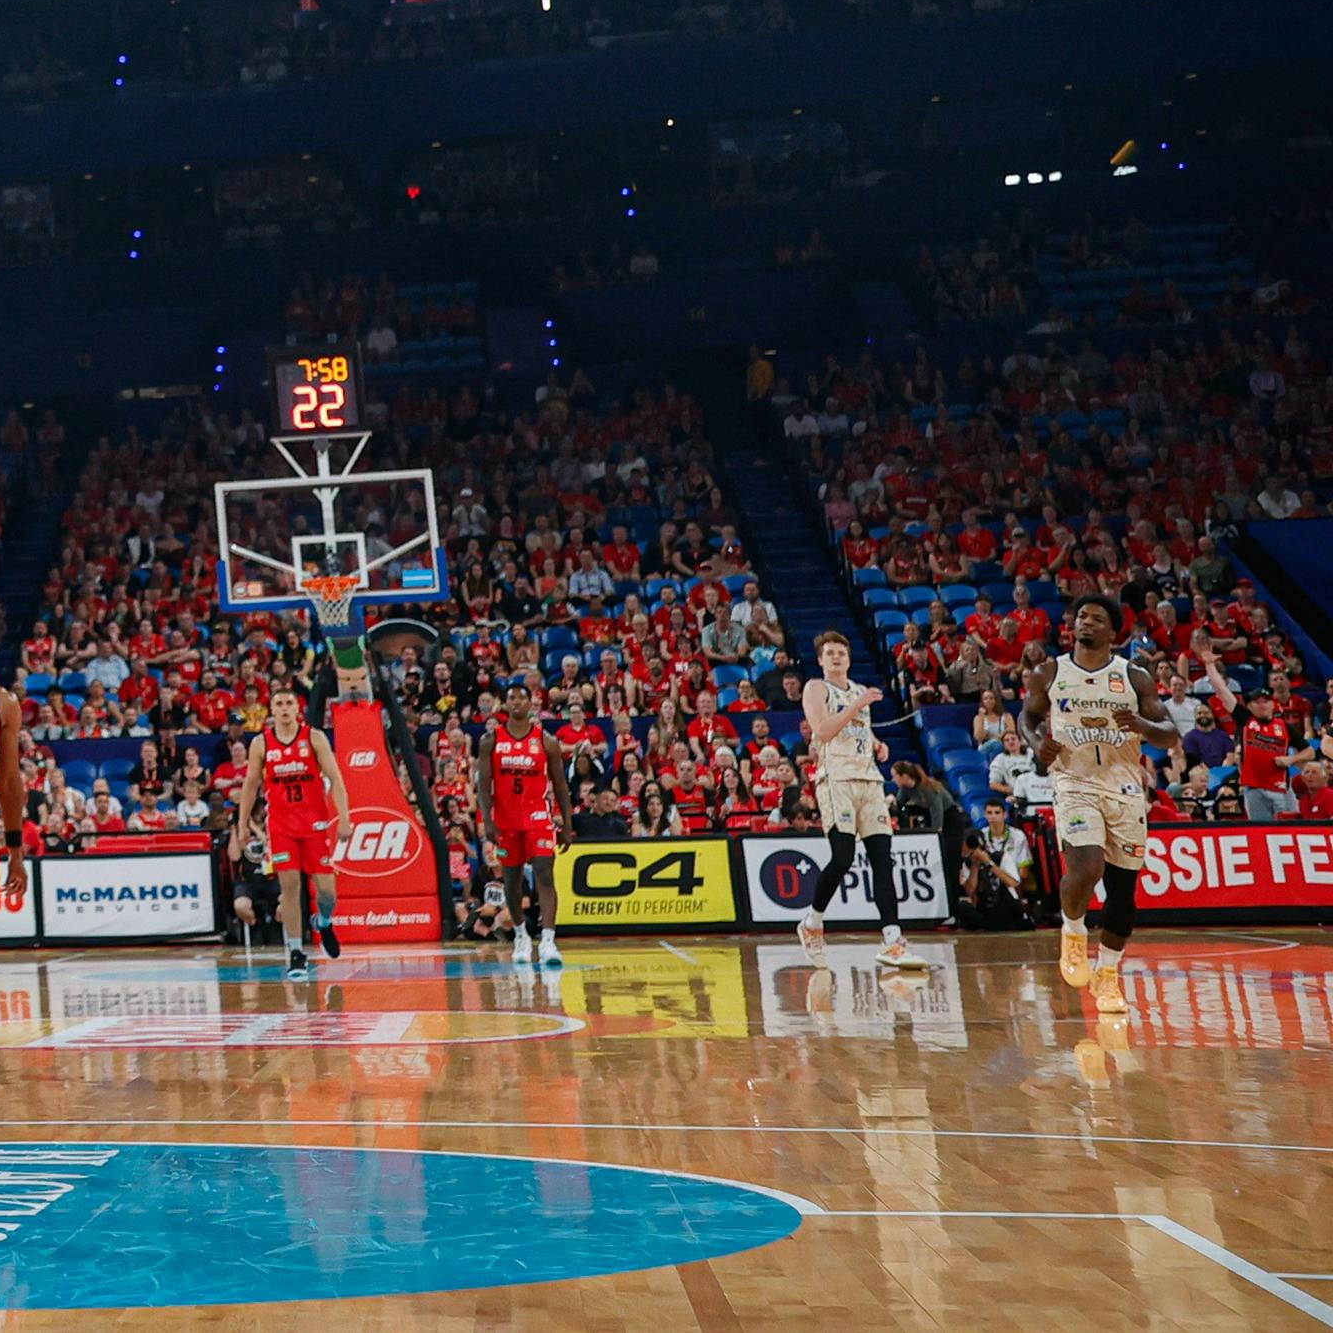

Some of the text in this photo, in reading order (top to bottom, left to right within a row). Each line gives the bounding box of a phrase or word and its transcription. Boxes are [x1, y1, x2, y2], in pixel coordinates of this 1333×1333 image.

[297, 356, 349, 383] 7:58
[292, 384, 345, 429] 22
[1071, 697, 1130, 711] Kenfrost
[348, 750, 376, 767] IGA
[1094, 744, 1102, 766] 1
[286, 784, 303, 803] 13
[513, 777, 524, 795] 5
[572, 851, 705, 898] C4
[1140, 833, 1333, 897] SSIE FE
[56, 883, 199, 903] McMAHON
[56, 902, 200, 914] SERVICES
[573, 897, 704, 916] ENERGY TO PERFORM
